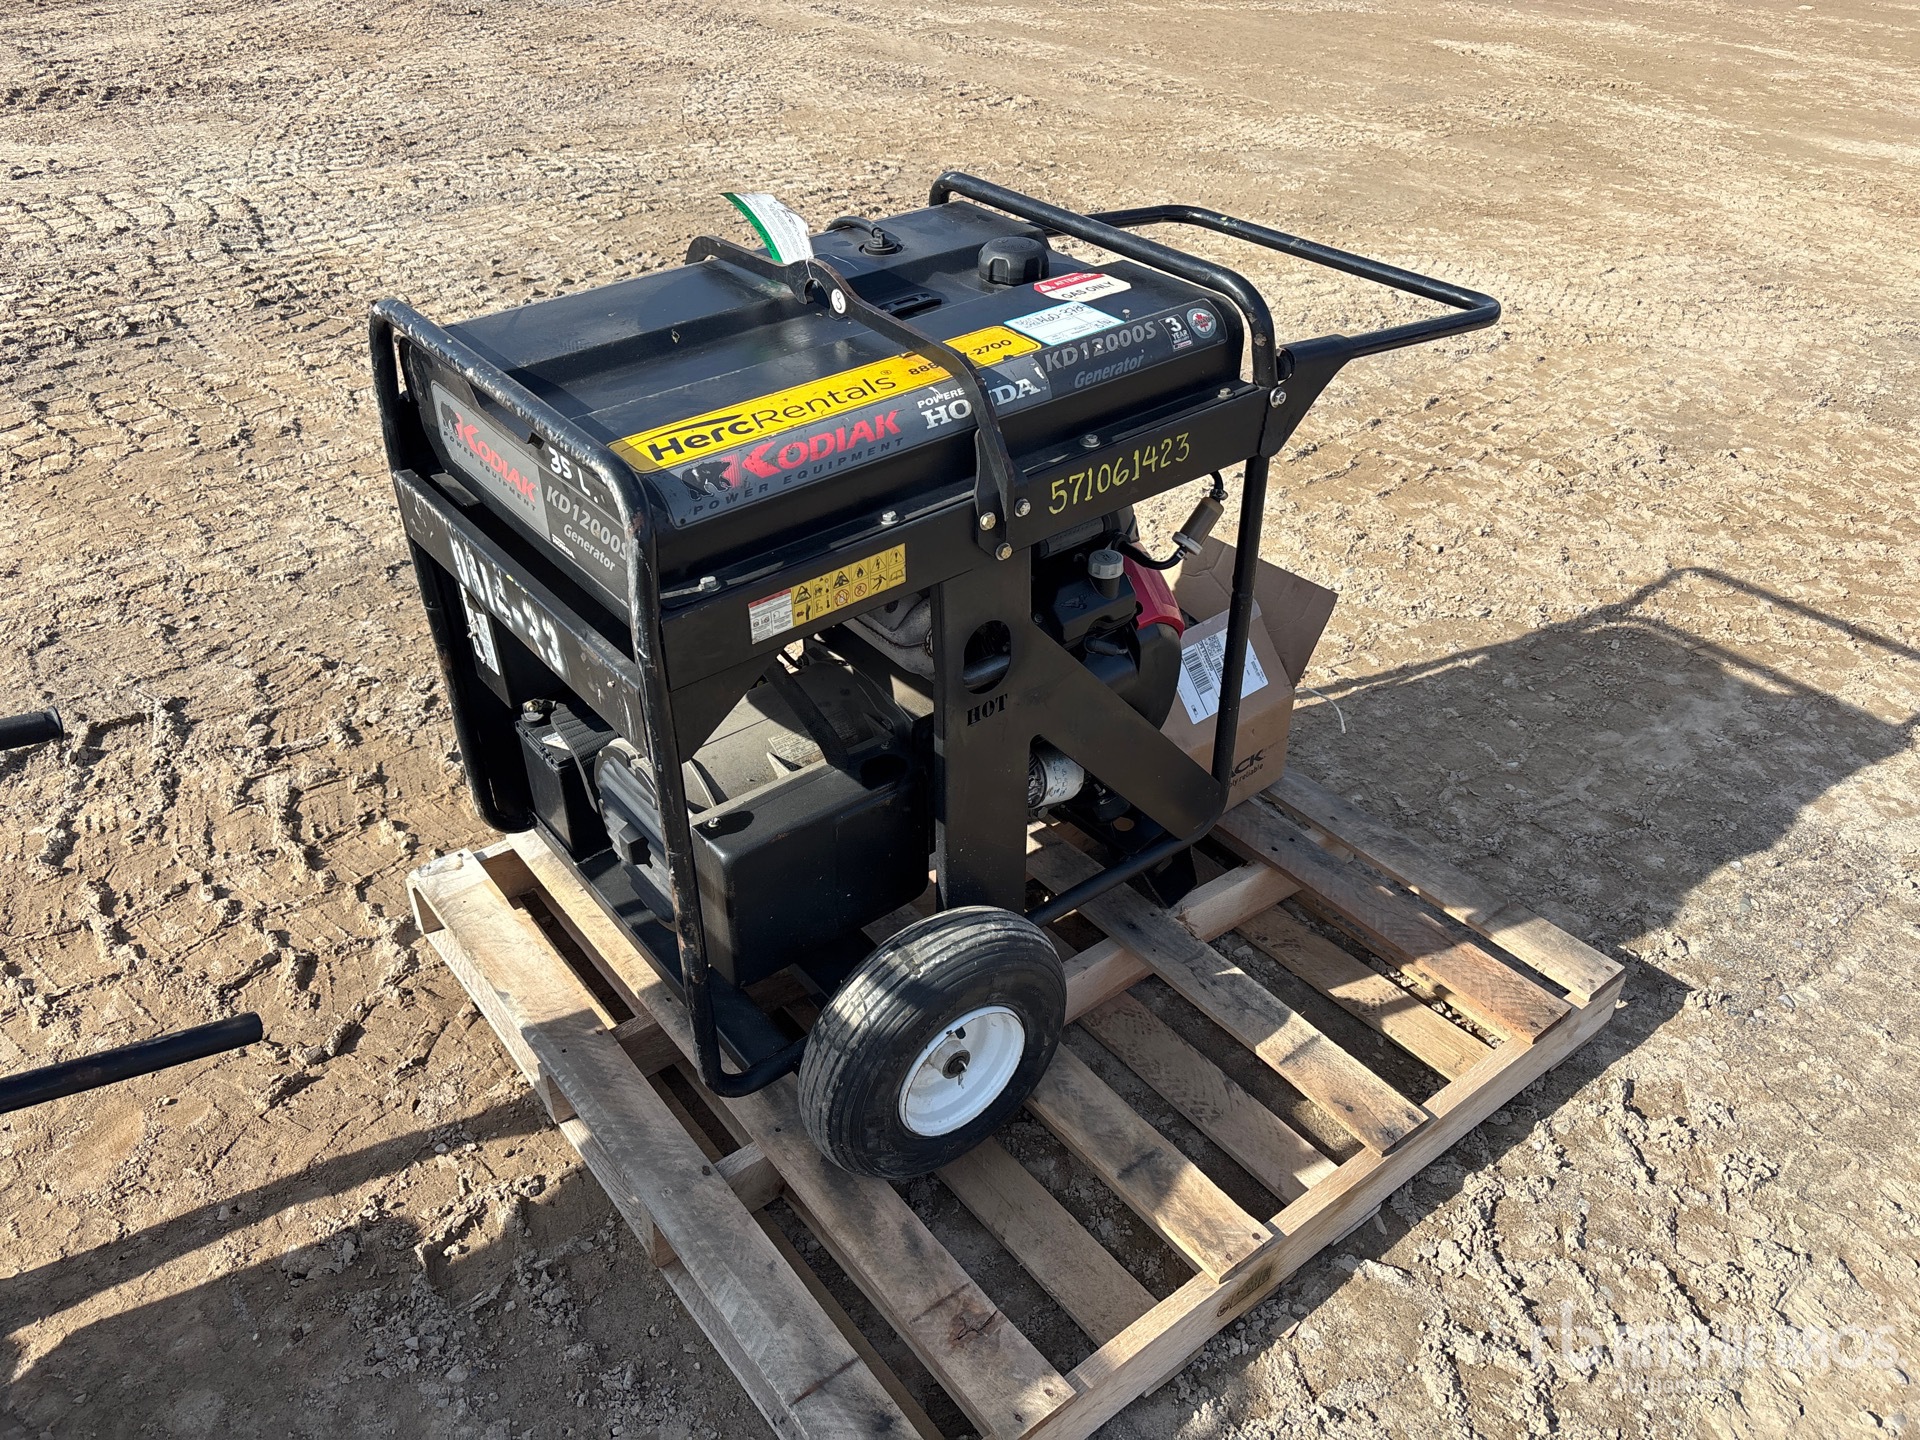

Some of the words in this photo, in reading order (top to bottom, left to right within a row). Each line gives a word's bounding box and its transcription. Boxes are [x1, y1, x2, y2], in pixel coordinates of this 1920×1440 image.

[1061, 289, 1085, 300] GAS
[1085, 281, 1115, 293] ONLY
[1045, 321, 1157, 373] KD12000S
[1165, 317, 1182, 332] 3
[1171, 330, 1190, 341] YEAR
[1074, 354, 1145, 389] Generator
[647, 376, 897, 462] HercRentals
[443, 430, 475, 459] POWER
[479, 460, 537, 511] EQUIPMENT
[457, 412, 537, 503] KODIAK
[548, 446, 573, 480] 35
[722, 409, 901, 488] KODIAK
[1048, 432, 1191, 515] 571061423
[692, 481, 769, 516] POWER
[783, 437, 904, 486] EQUIPMENT
[546, 485, 628, 561] KD12000S
[563, 523, 616, 571] Generator
[967, 693, 1008, 727] HOT
[1239, 763, 1264, 782] reliable
